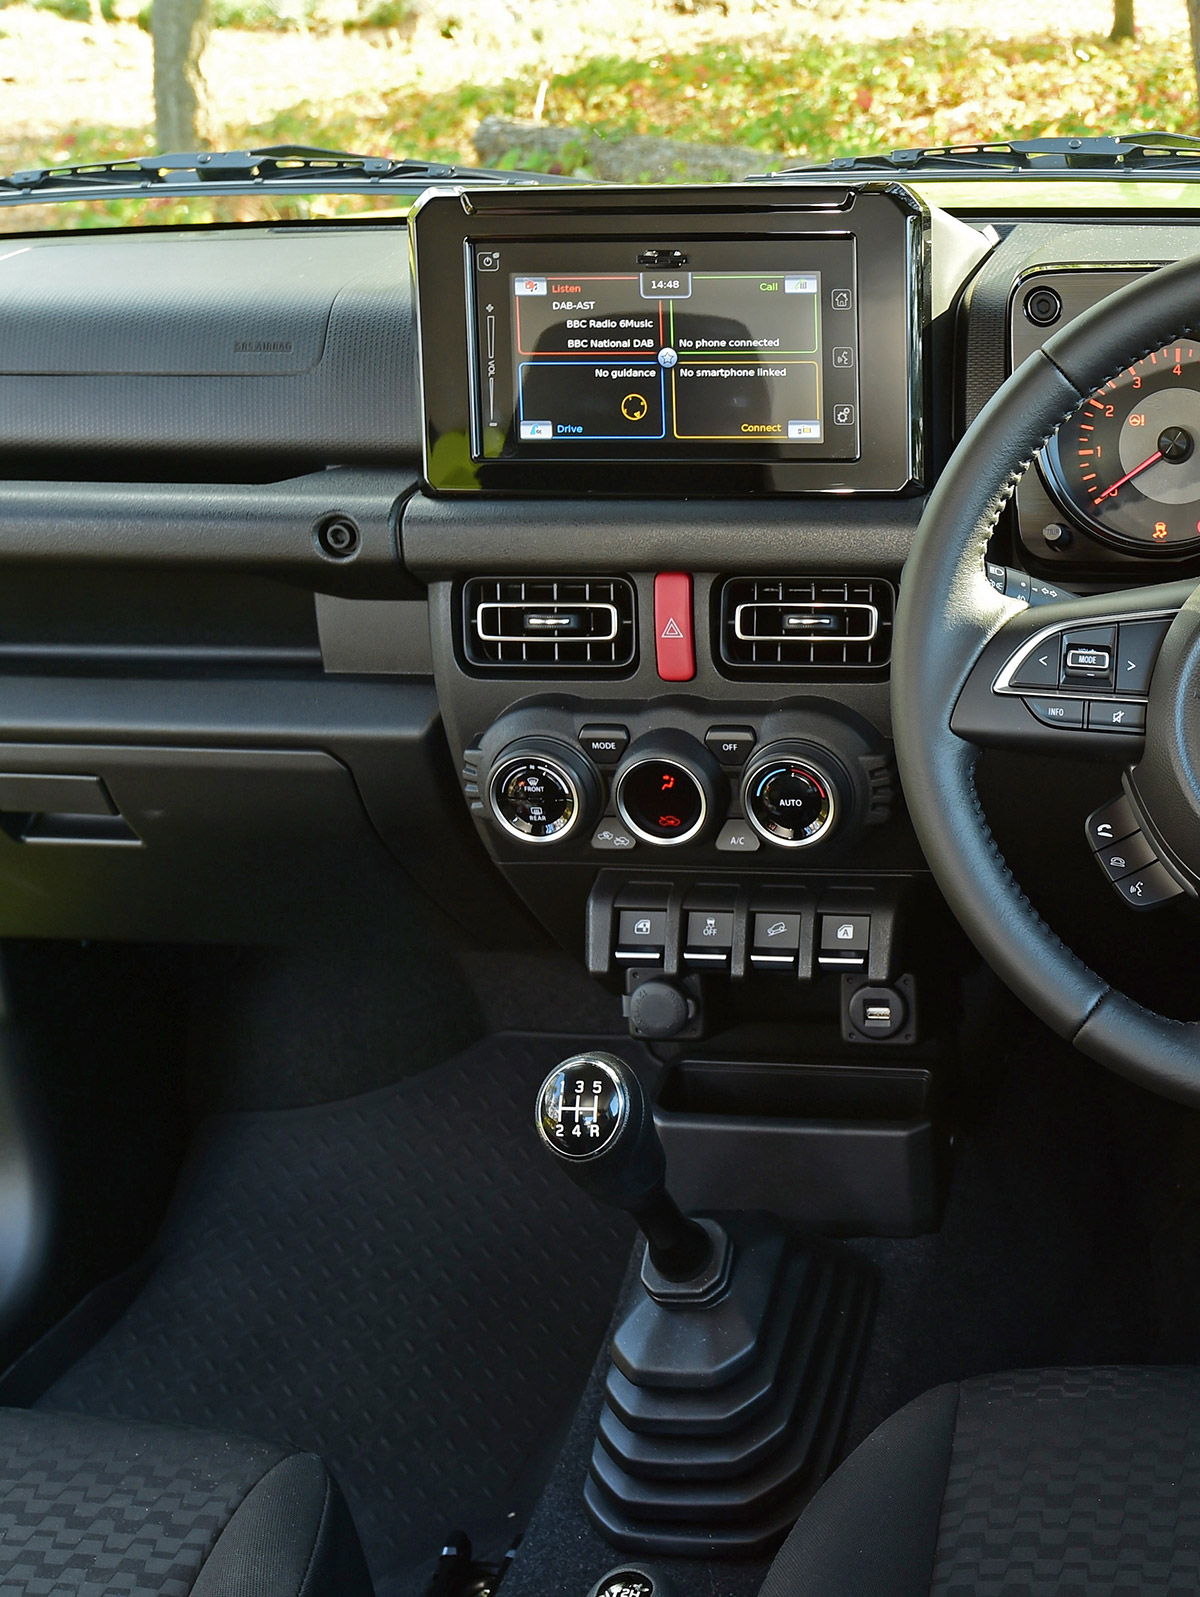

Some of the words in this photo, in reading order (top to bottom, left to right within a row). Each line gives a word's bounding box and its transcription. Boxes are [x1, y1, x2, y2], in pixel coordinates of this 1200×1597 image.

[551, 284, 581, 293] Listen
[651, 280, 680, 289] 14:48
[759, 282, 778, 291] Call
[552, 301, 596, 310] DAB-AST
[566, 320, 587, 328] BBC
[589, 320, 617, 328] Radio
[619, 319, 654, 328] 6Music
[567, 340, 588, 348] BBC
[590, 339, 631, 348] National
[633, 340, 654, 348] DAB
[678, 339, 693, 347] No
[695, 339, 727, 349] phone
[728, 338, 780, 347] connected
[487, 360, 496, 377] VOL
[594, 369, 609, 377] No
[611, 368, 656, 379] guidance
[680, 368, 694, 377] No
[696, 368, 755, 379] smartphone
[757, 368, 787, 377] linked
[1172, 365, 1181, 375] 4
[1132, 377, 1142, 389] 3
[1105, 405, 1115, 417] 2
[557, 424, 583, 433] Drive
[740, 423, 782, 432] Connect
[1096, 447, 1102, 457] 1
[1078, 655, 1097, 664] MODE
[1048, 708, 1064, 716] INFO
[591, 741, 616, 751] MODE
[722, 742, 738, 752] OFF
[779, 799, 803, 807] AUTO
[730, 836, 745, 846] A/C
[702, 928, 718, 937] OFF
[560, 1080, 565, 1093] 1
[575, 1080, 584, 1093] 3
[592, 1080, 602, 1093] 5
[555, 1124, 564, 1137] 2
[572, 1124, 581, 1137] 4
[590, 1124, 599, 1137] R
